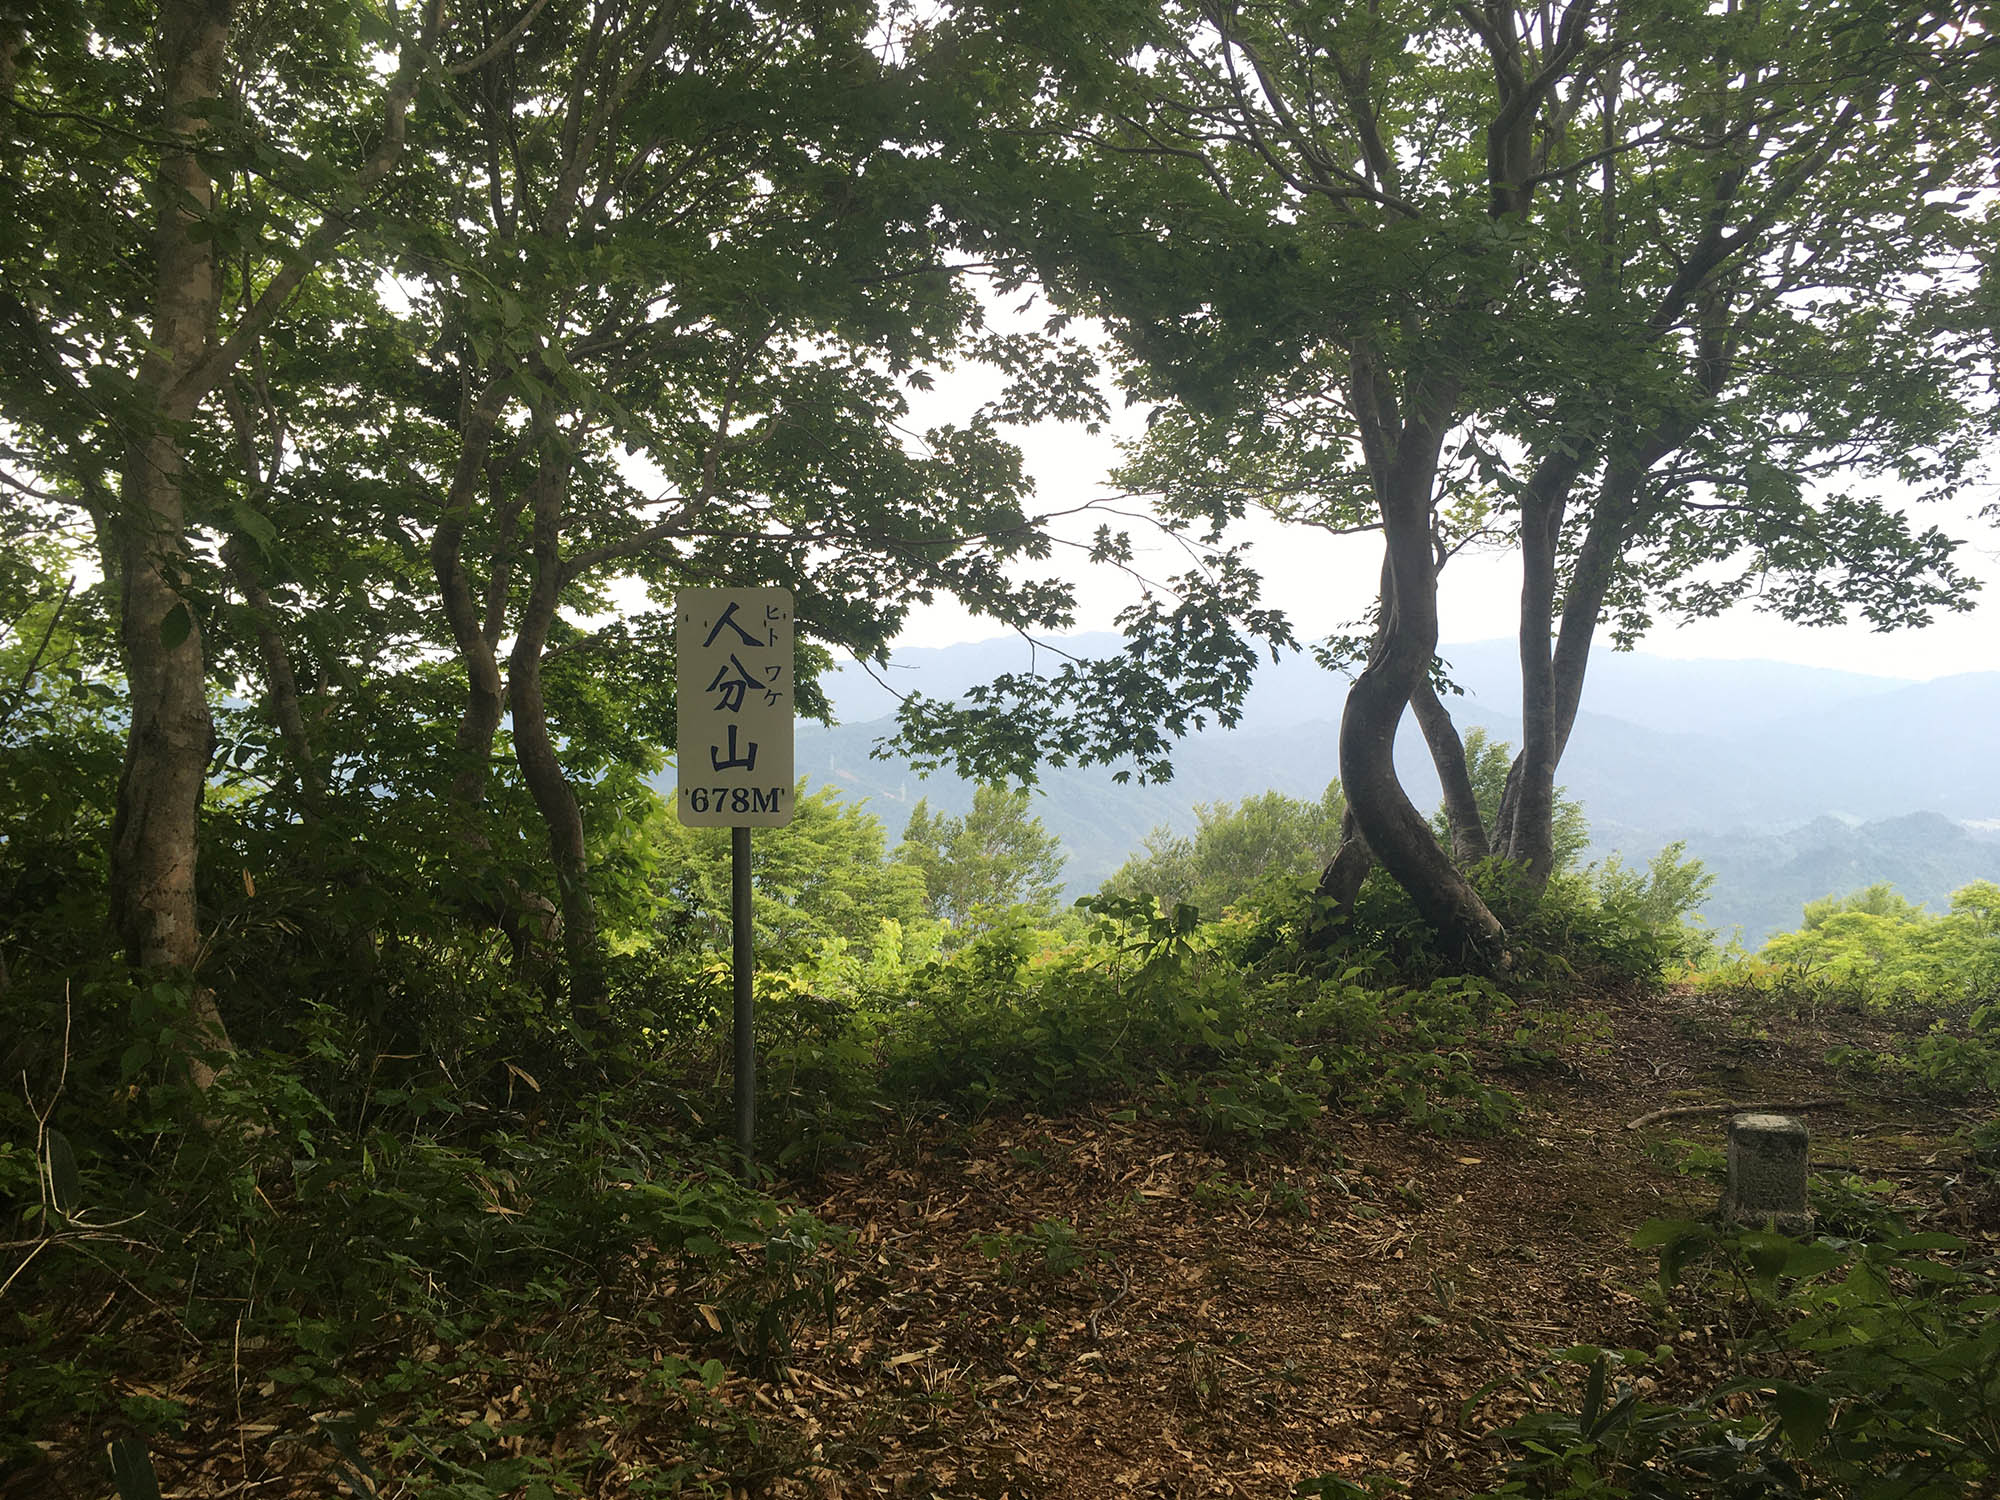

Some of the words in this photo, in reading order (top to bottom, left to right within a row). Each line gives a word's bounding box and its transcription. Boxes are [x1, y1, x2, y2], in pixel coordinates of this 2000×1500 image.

[702, 601, 766, 772] 人分山
[691, 787, 781, 813] 678M
